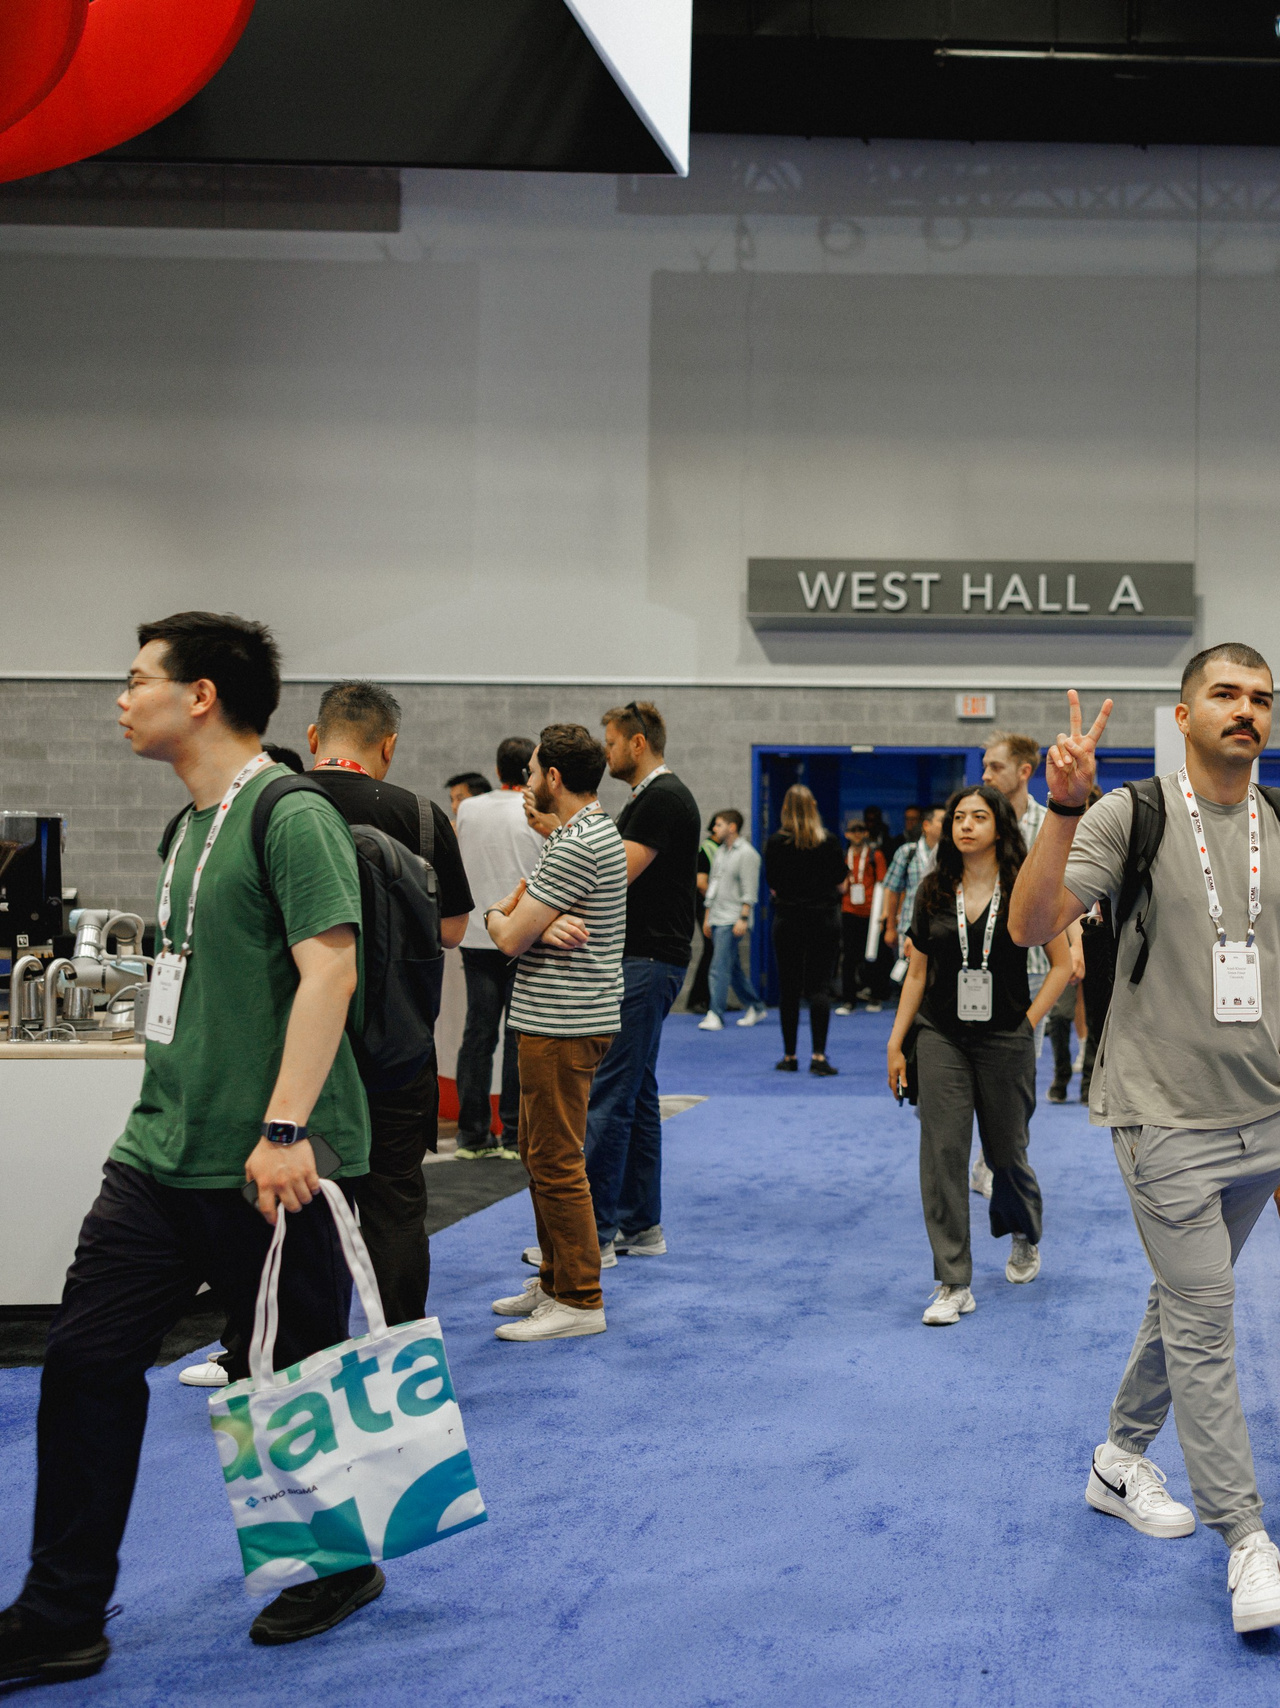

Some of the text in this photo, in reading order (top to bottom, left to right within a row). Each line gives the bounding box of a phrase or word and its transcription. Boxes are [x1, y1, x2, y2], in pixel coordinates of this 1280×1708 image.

[798, 571, 1145, 613] WEST HALL A
[261, 1485, 318, 1503] TWO SIGMA
